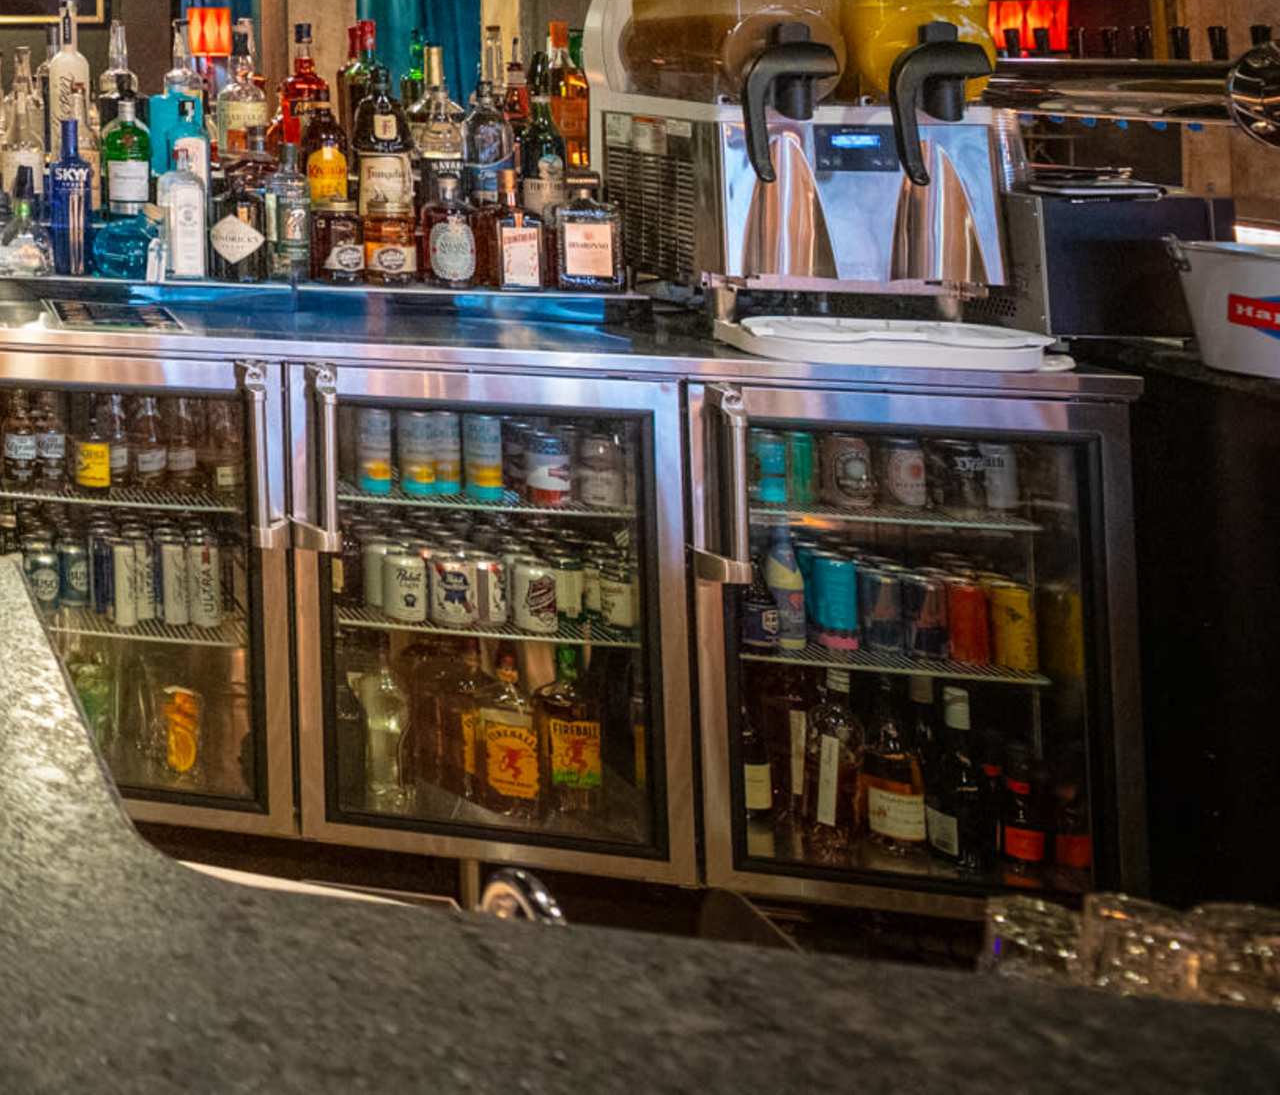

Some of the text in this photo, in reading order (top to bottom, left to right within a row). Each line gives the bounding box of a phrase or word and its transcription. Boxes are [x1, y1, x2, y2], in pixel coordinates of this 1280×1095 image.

[54, 167, 89, 181] SKYY
[201, 570, 214, 612] ULTRA
[552, 722, 598, 739] FIREBALL
